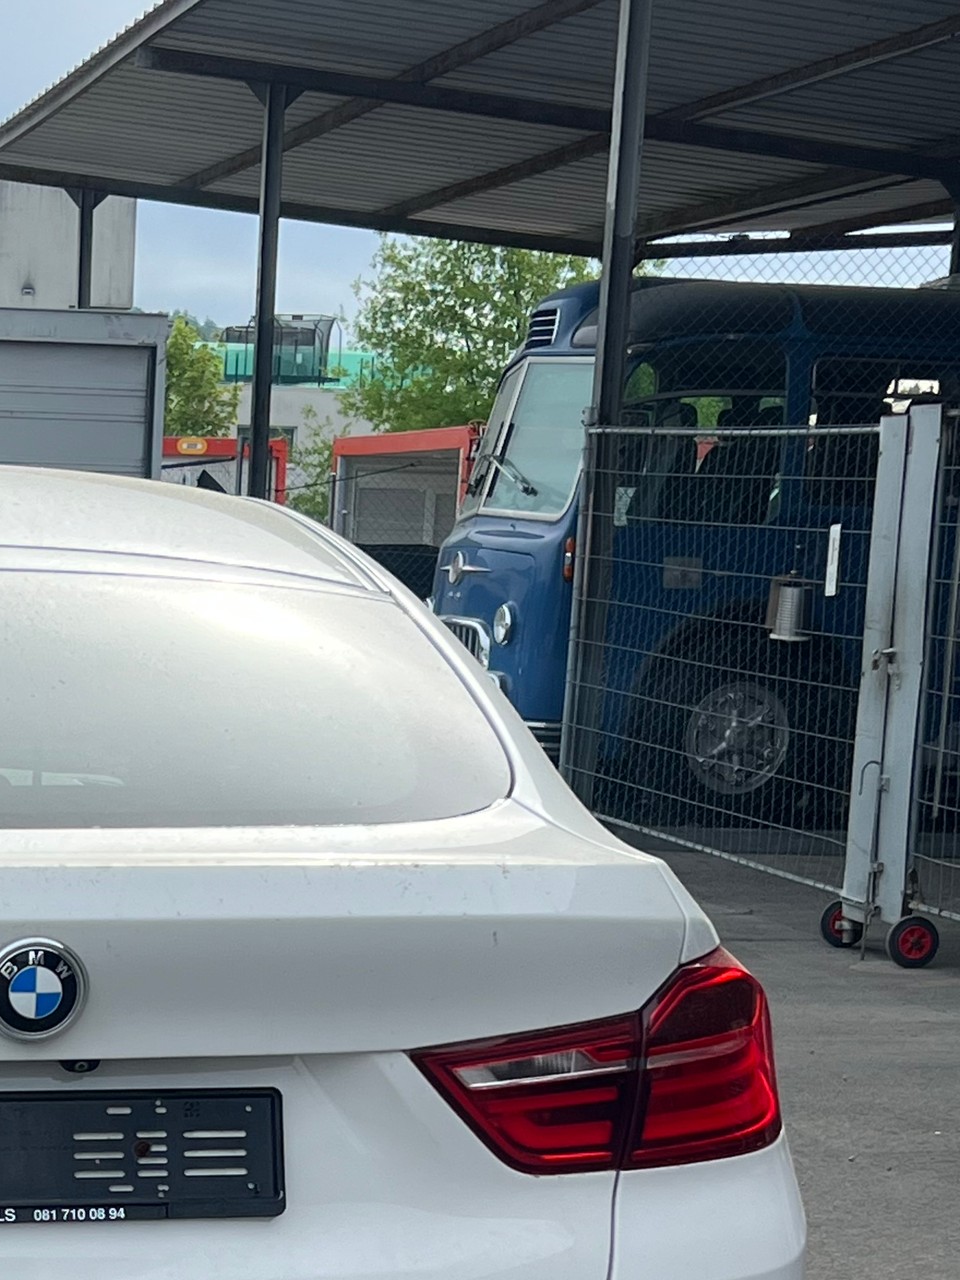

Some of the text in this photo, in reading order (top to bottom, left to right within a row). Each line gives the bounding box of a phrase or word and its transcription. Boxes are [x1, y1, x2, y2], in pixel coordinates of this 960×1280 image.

[0, 951, 71, 980] BMW
[34, 1209, 56, 1221] 081
[62, 1208, 86, 1220] 710
[89, 1208, 106, 1220] 08
[108, 1207, 126, 1219] 94
